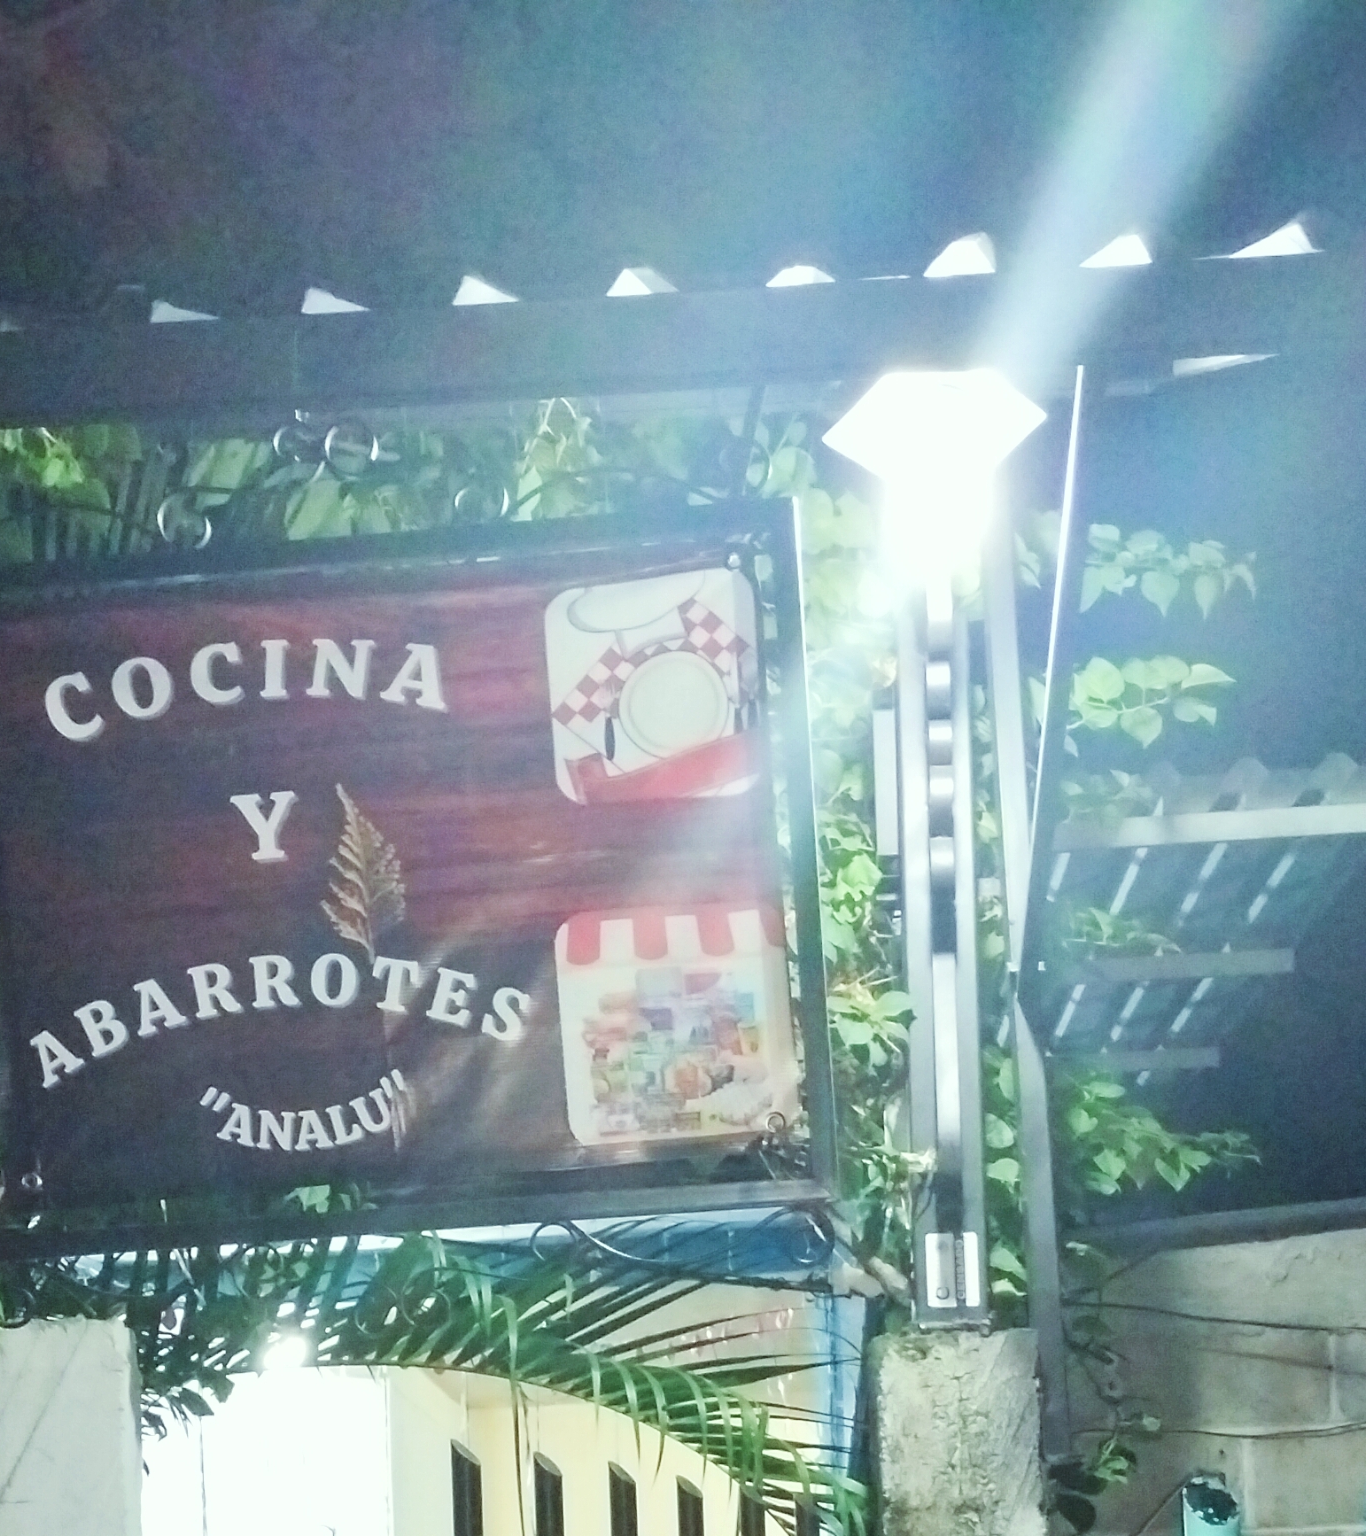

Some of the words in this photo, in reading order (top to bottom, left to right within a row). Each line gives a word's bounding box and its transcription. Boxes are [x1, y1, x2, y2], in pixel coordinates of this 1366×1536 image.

[44, 638, 447, 741] COCINA
[231, 791, 296, 862] Y
[30, 952, 532, 1089] ABARROTES
[199, 1069, 405, 1152] "ANALU"
